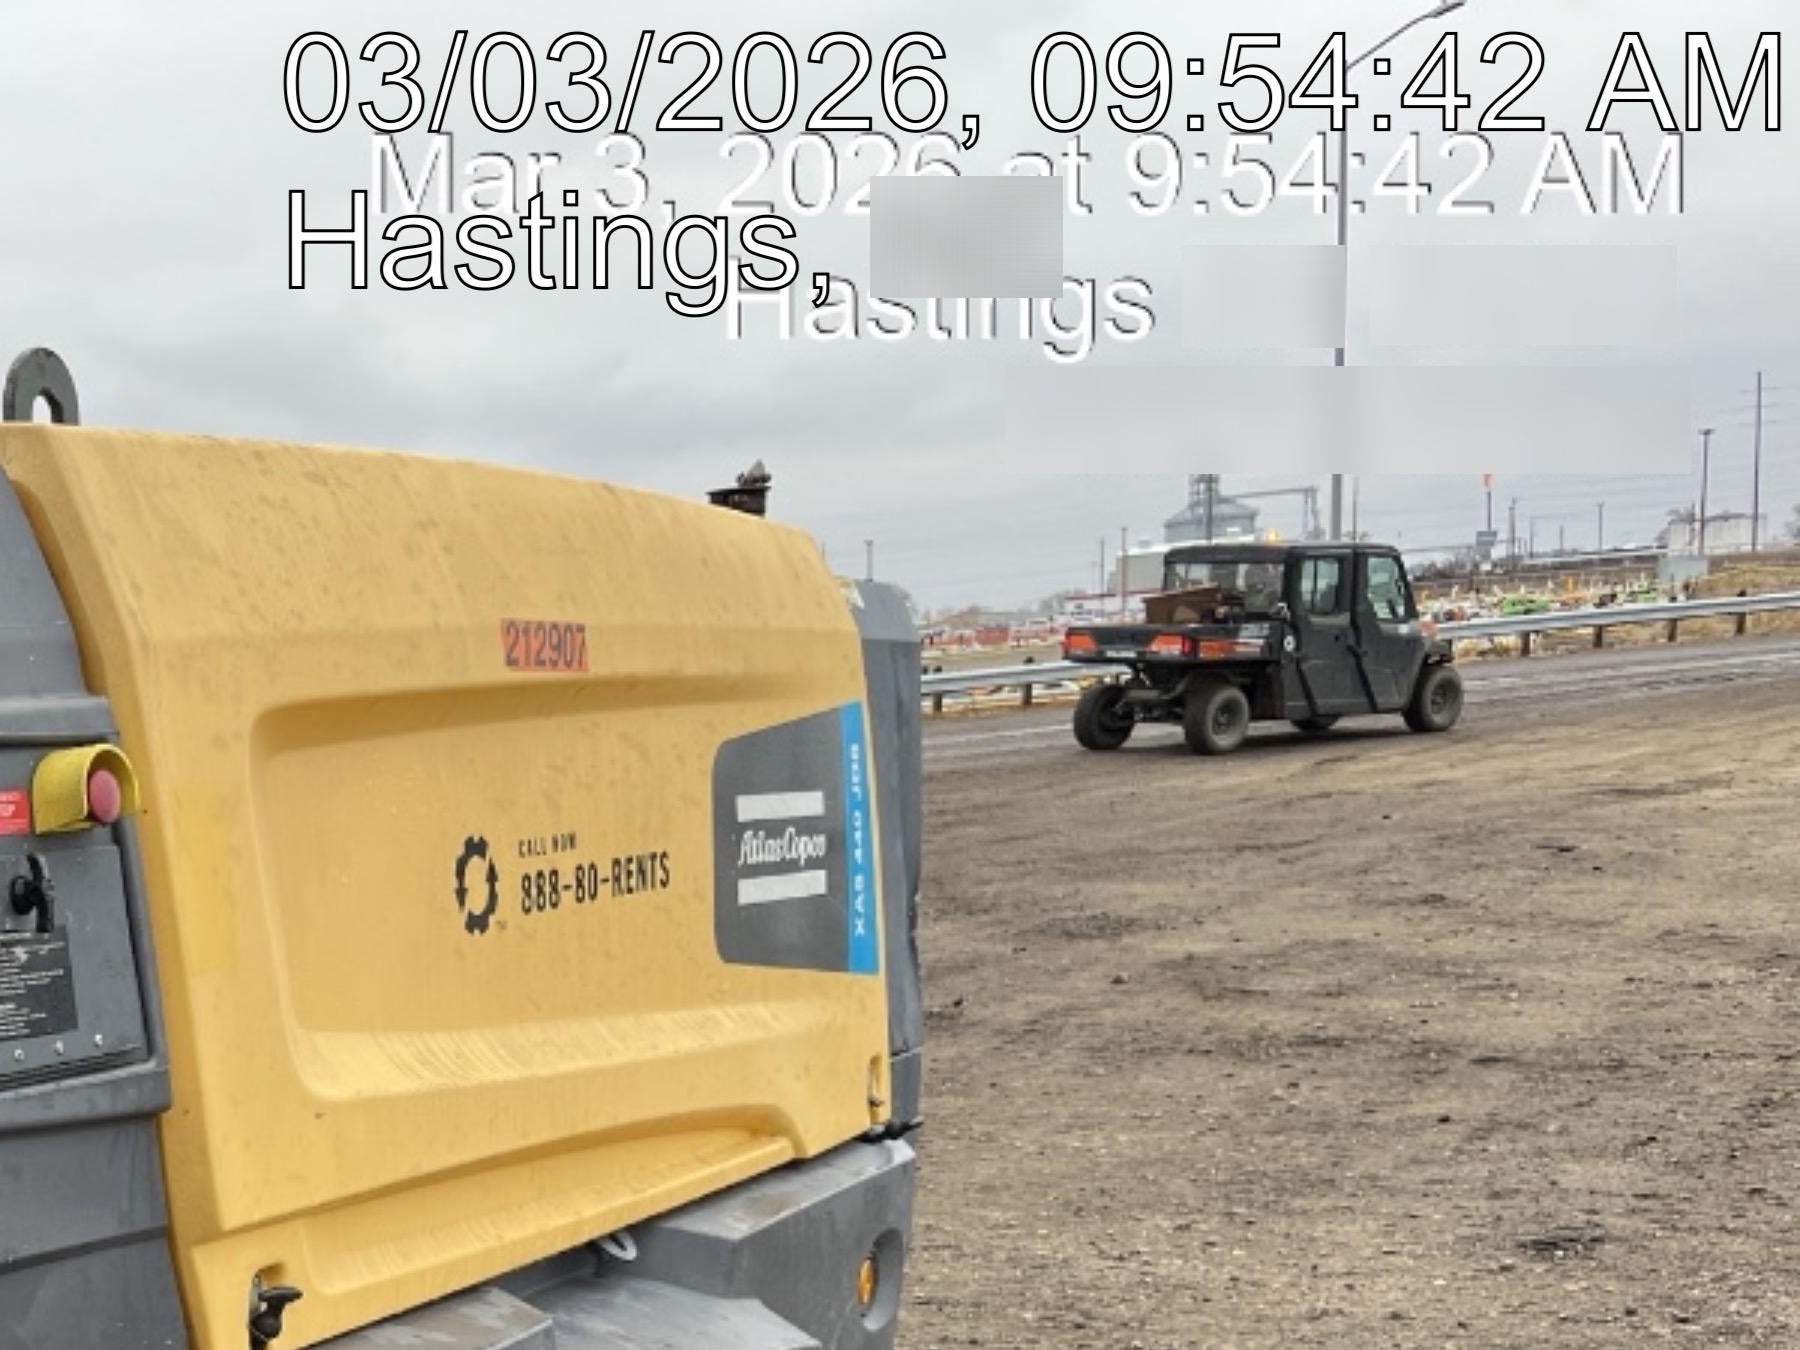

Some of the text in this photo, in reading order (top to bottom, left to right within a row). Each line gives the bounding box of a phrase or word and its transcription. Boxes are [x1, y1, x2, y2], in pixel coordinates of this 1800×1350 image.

[505, 621, 586, 667] 212907
[519, 833, 577, 859] CALL NOW
[521, 850, 670, 915] 888-80-RENTS
